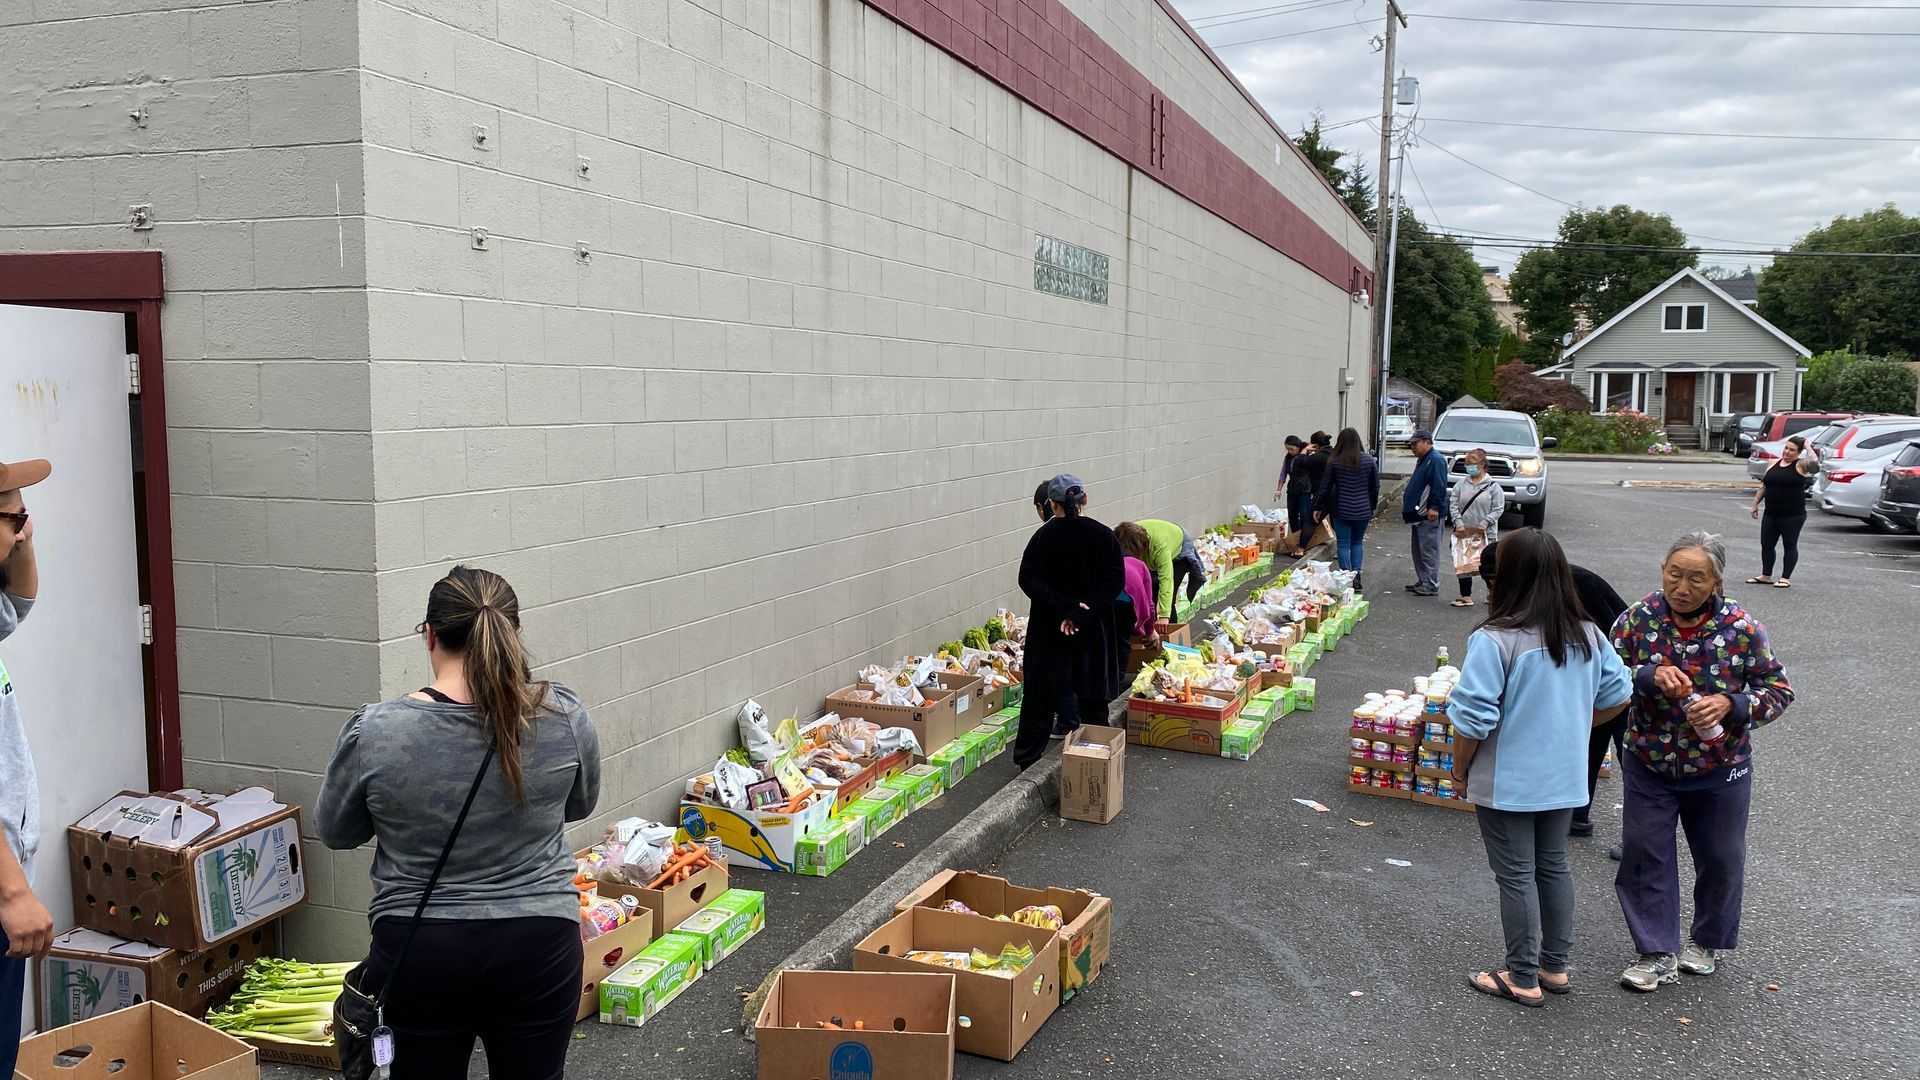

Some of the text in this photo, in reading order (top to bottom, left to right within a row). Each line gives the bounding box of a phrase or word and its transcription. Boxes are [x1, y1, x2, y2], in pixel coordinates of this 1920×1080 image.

[123, 811, 160, 825] CELERY
[230, 868, 245, 916] DESTINY
[209, 891, 222, 933] CELERY
[199, 959, 245, 994] THIS SIDE UP
[604, 985, 636, 999] WATERLOO
[657, 961, 687, 992] WATERLOO
[293, 1051, 335, 1066] SUGAR
